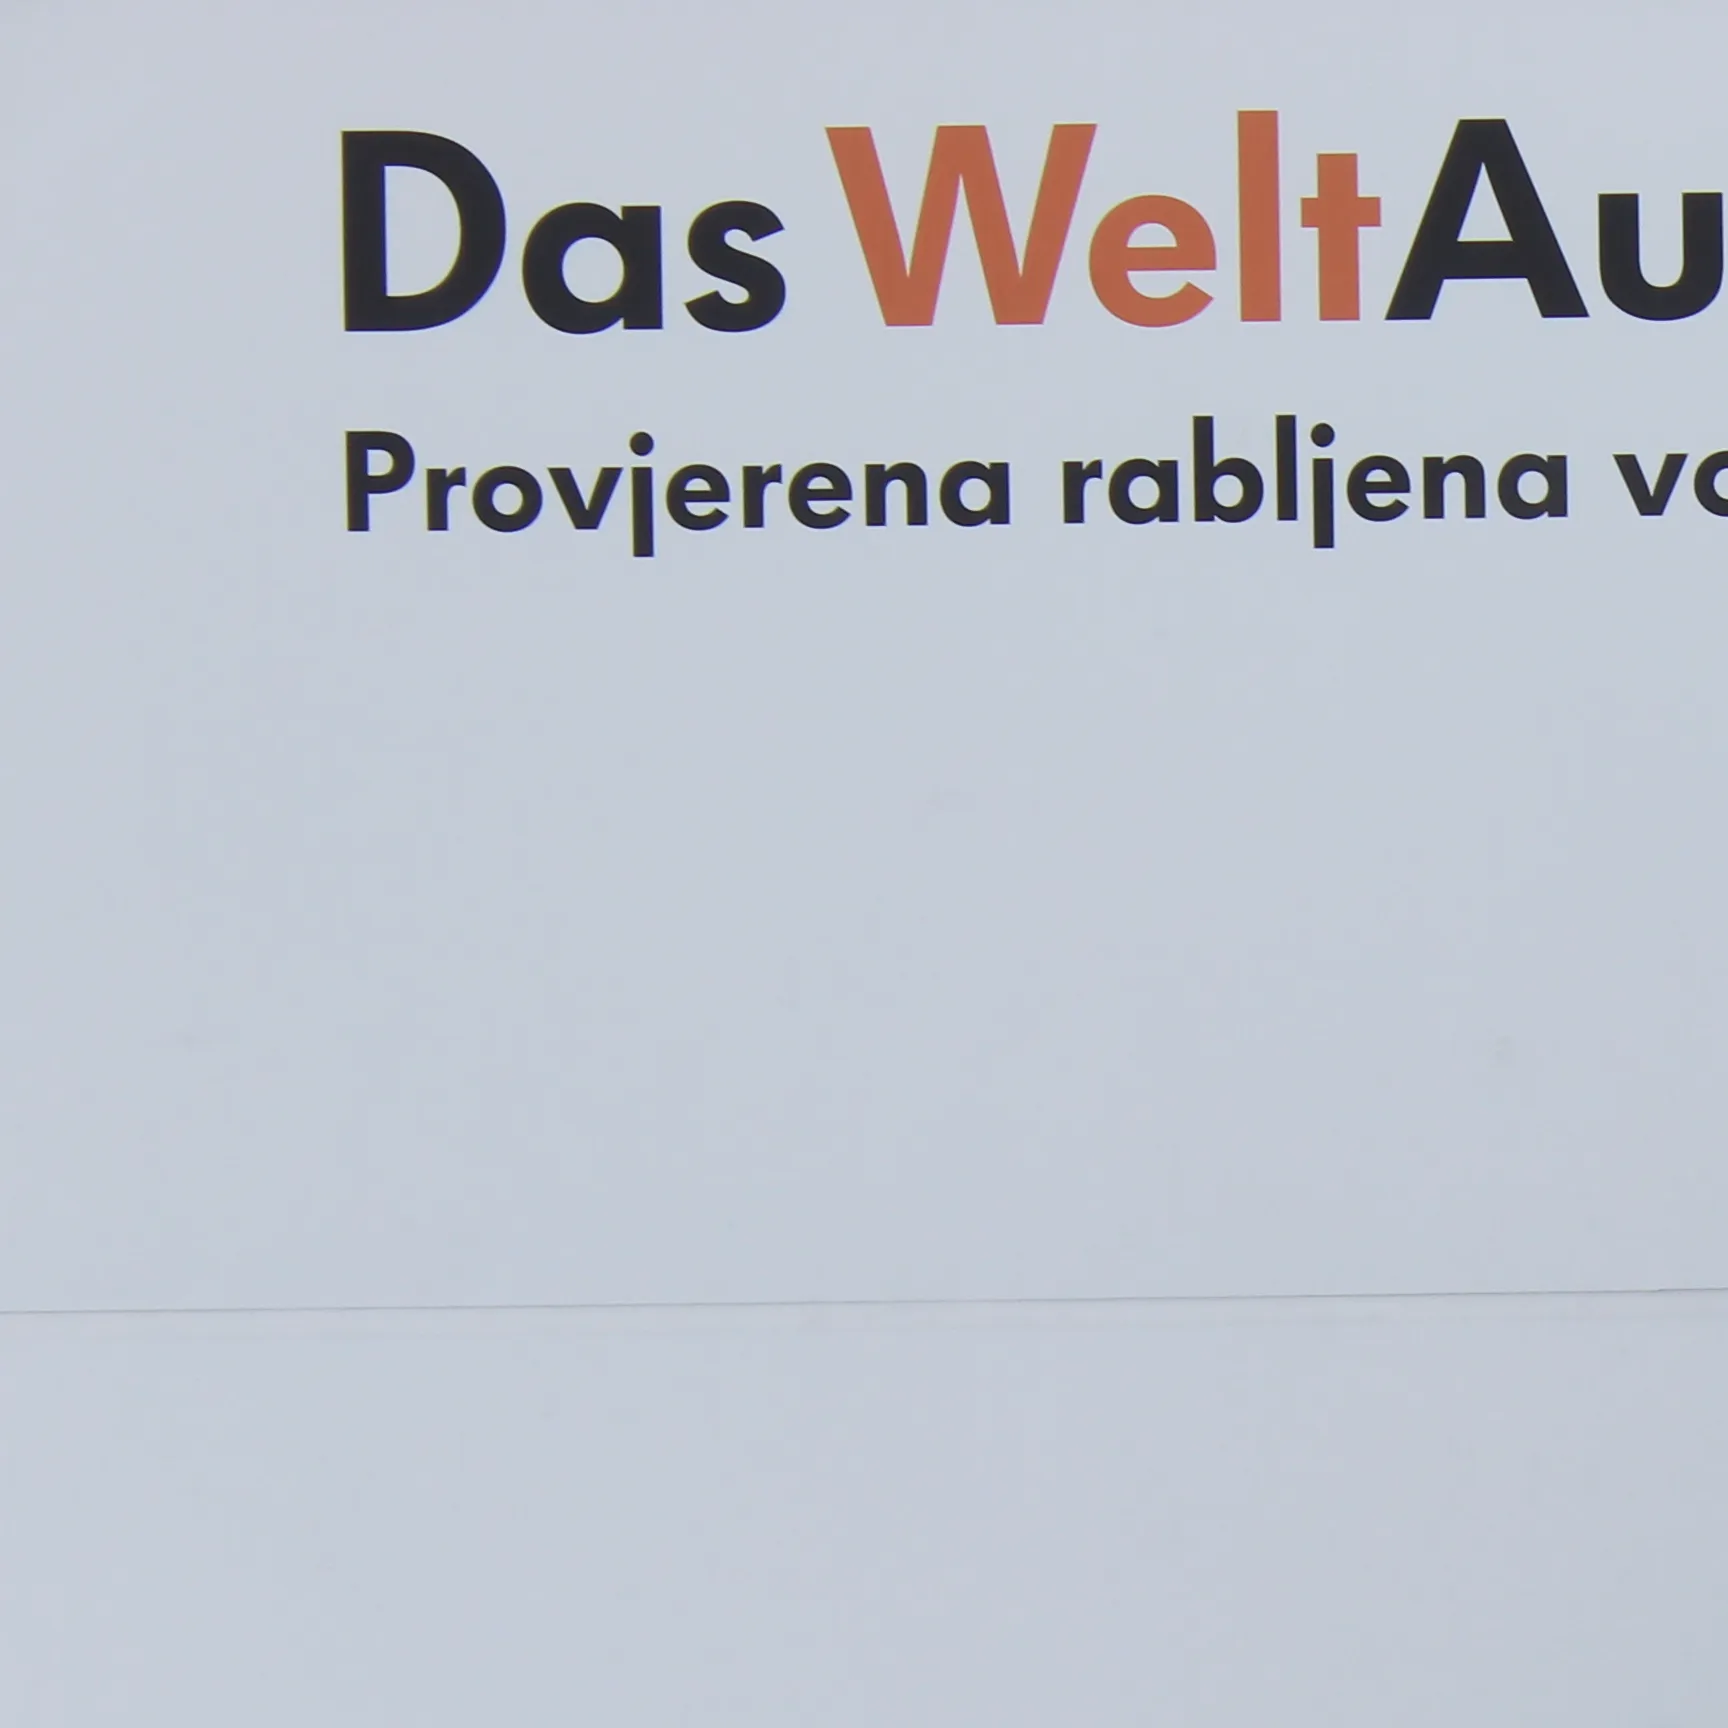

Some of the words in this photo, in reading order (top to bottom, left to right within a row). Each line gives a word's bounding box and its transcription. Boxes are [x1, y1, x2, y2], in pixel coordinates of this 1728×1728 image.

[339, 129, 786, 335] Das
[344, 429, 1012, 559] Provjerena
[1061, 413, 1569, 550] rabljena
